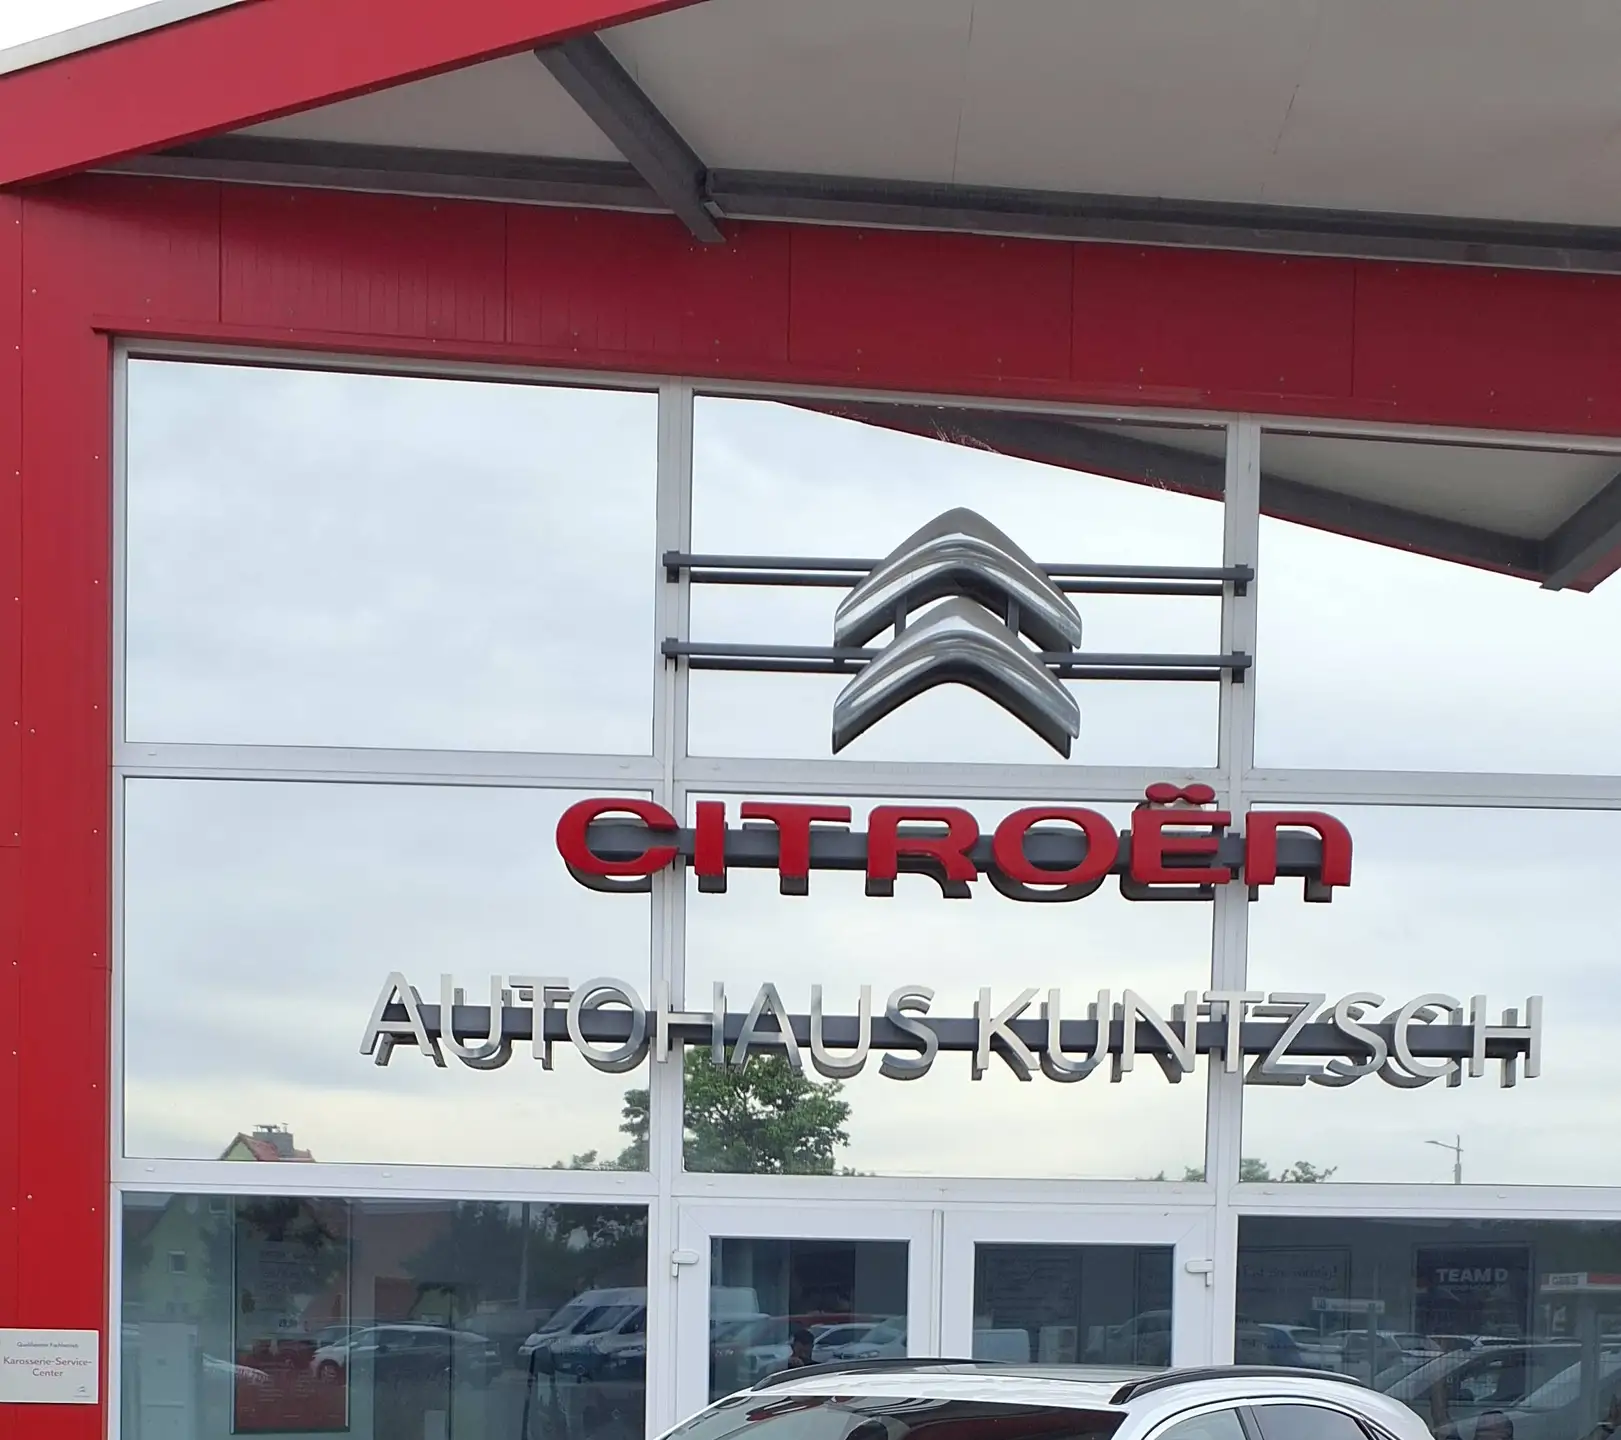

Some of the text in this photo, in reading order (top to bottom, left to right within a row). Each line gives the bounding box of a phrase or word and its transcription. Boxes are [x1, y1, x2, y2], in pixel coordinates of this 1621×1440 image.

[359, 970, 1543, 1084] AUTOHAUS KUNTZSCH
[1436, 1268, 1490, 1283] TEAM
[32, 1367, 63, 1377] Center
